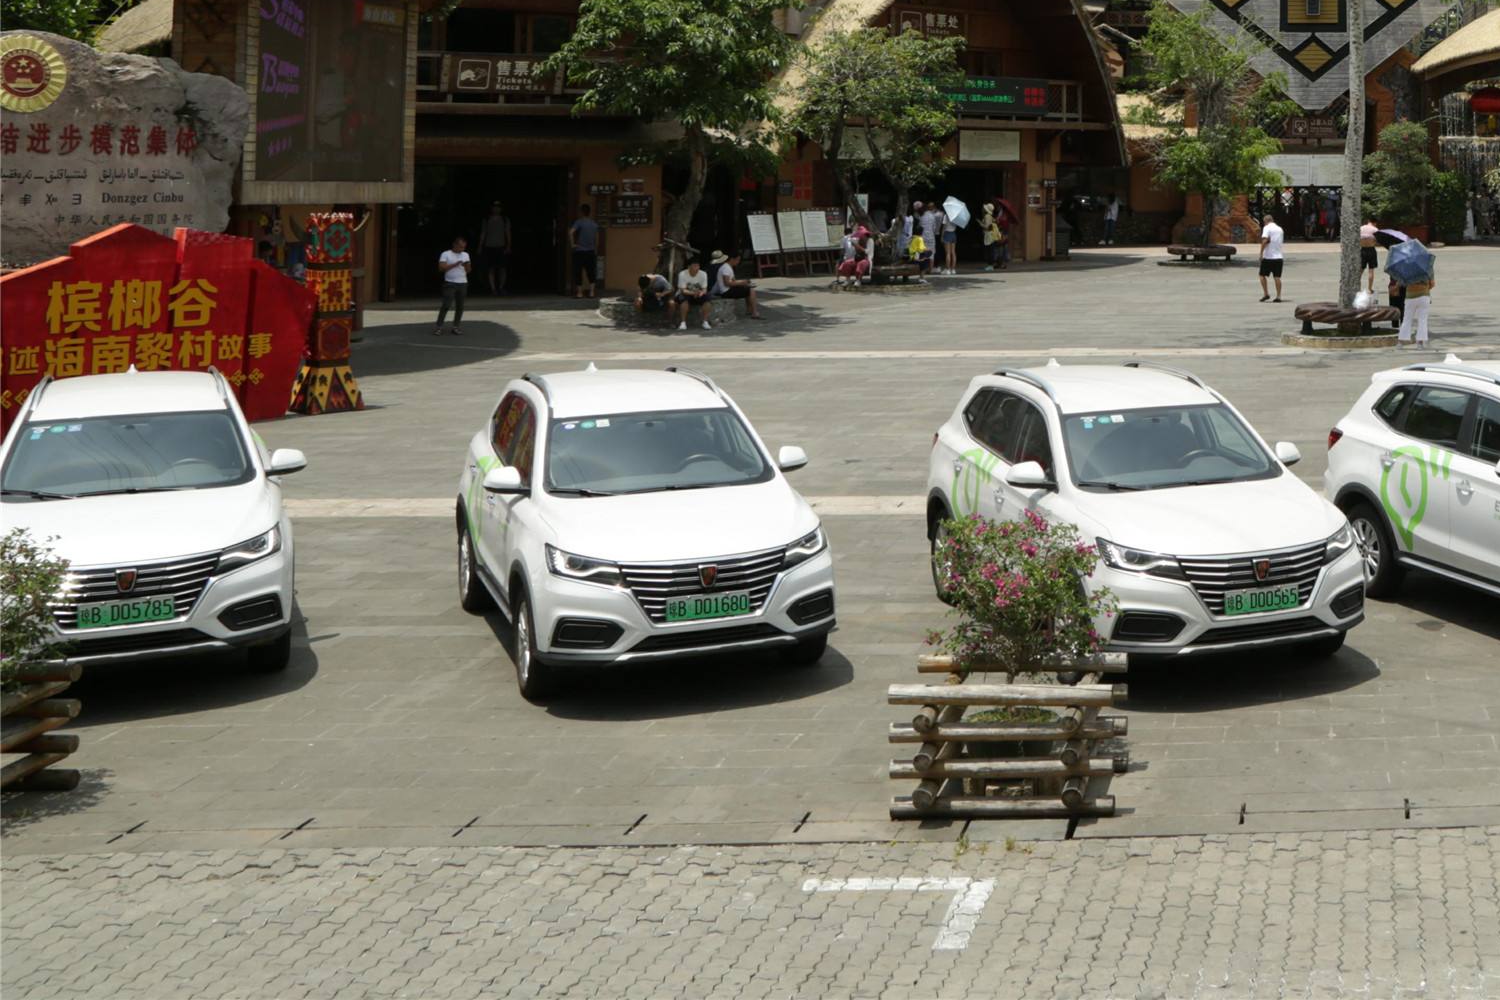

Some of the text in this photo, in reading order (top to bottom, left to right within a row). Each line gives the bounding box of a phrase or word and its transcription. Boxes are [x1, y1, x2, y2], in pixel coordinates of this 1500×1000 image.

[497, 76, 532, 85] Tickets
[153, 192, 184, 203] Cinbu
[46, 279, 218, 334] 槟榔谷
[0, 330, 272, 379] 述海南黎村故事
[694, 594, 748, 616] D01680
[1250, 588, 1297, 609] D00565
[111, 599, 173, 621] D05785
